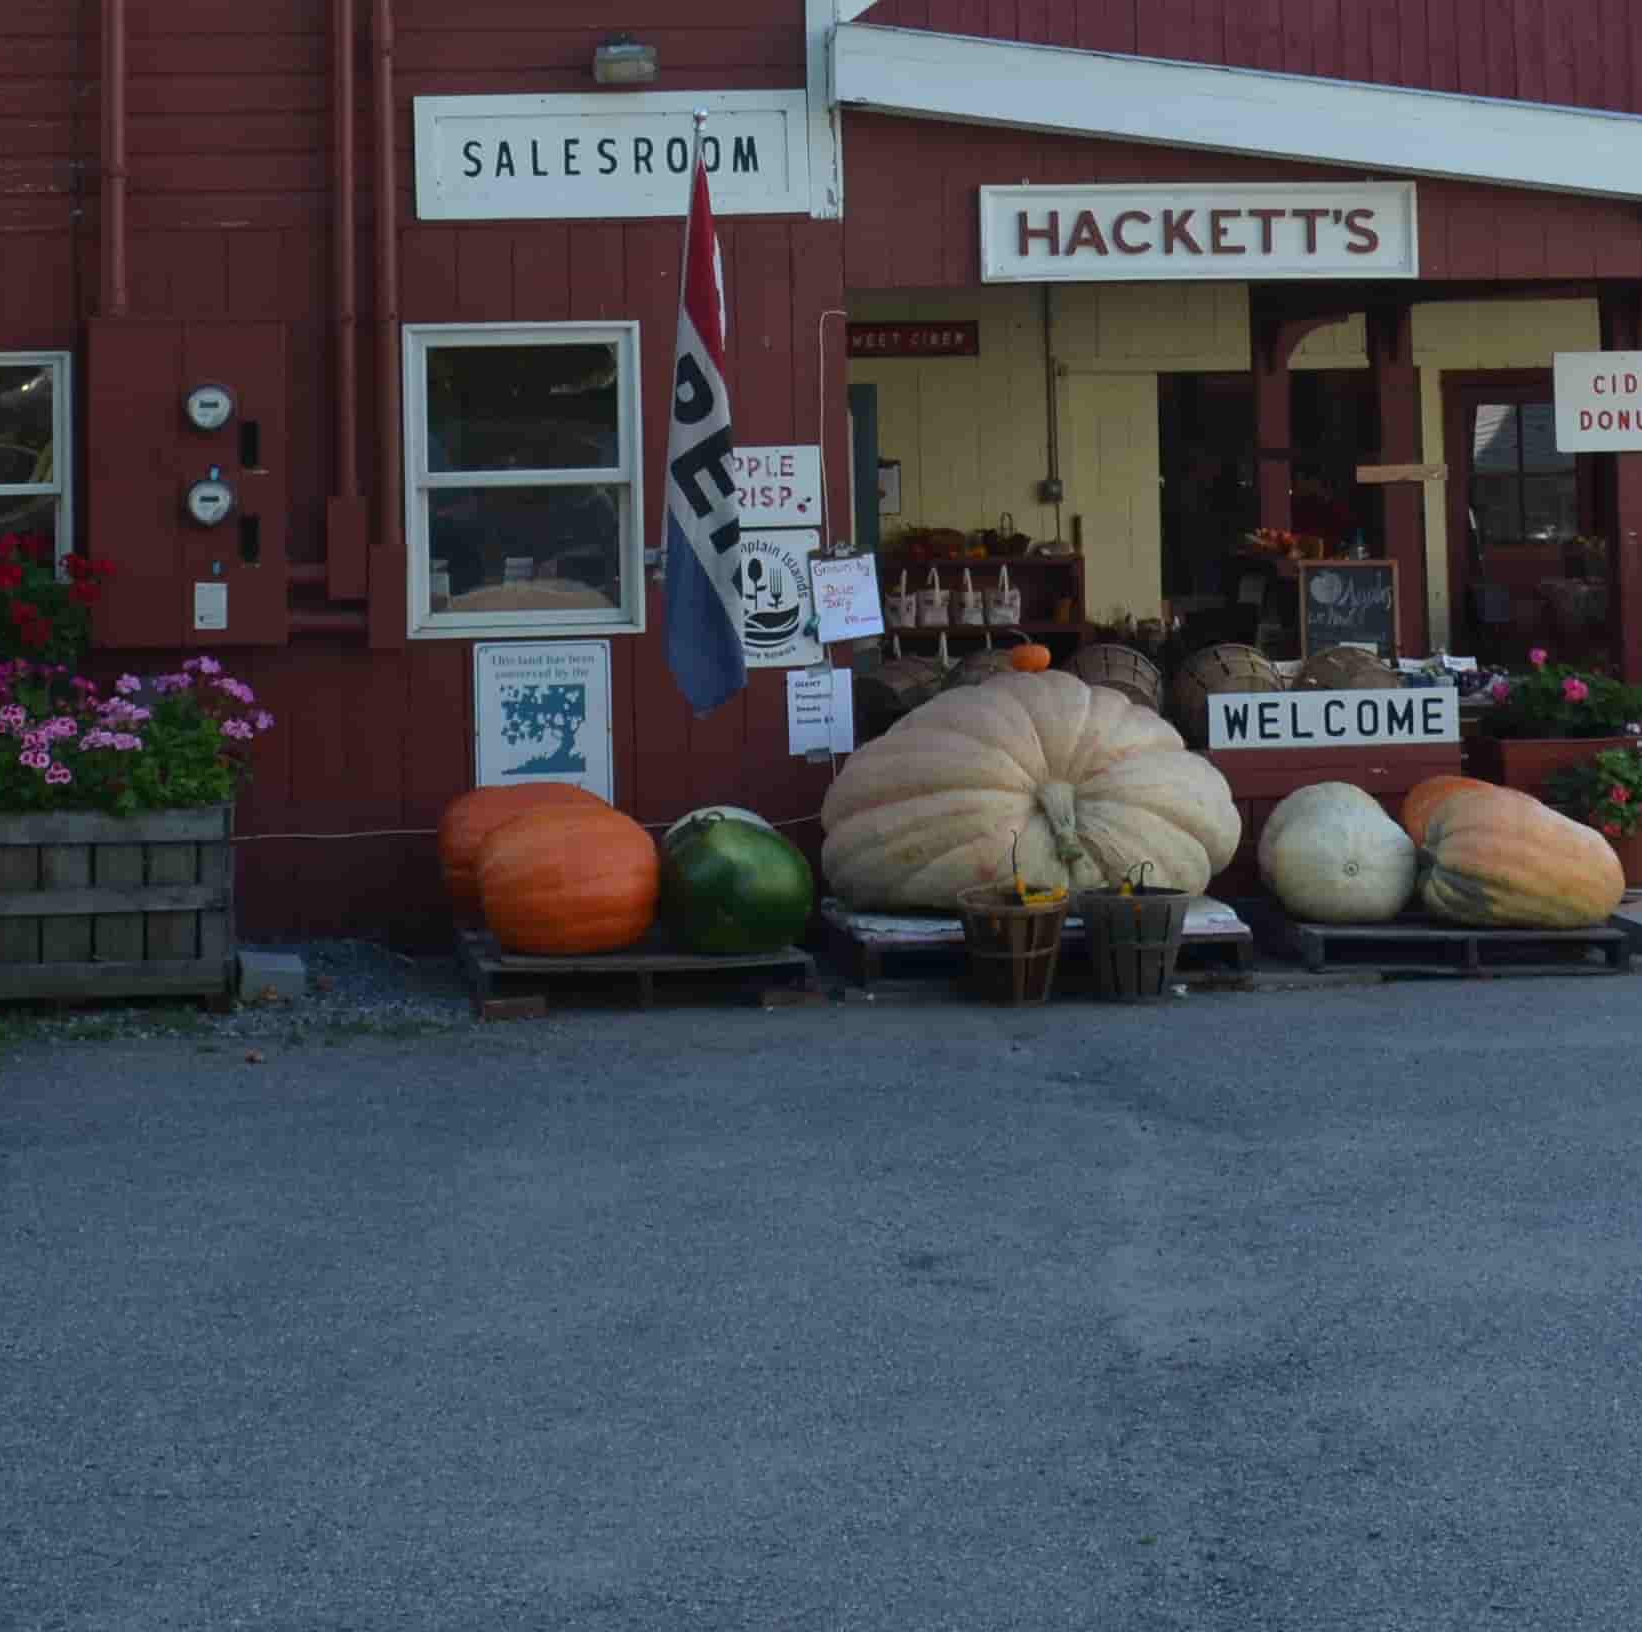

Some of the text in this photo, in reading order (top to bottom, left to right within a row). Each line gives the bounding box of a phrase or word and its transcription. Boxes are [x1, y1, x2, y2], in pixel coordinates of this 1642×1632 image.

[462, 135, 759, 178] SALESROOM
[1017, 207, 1381, 257] HACKETT'S
[1223, 696, 1446, 741] WELCOME
